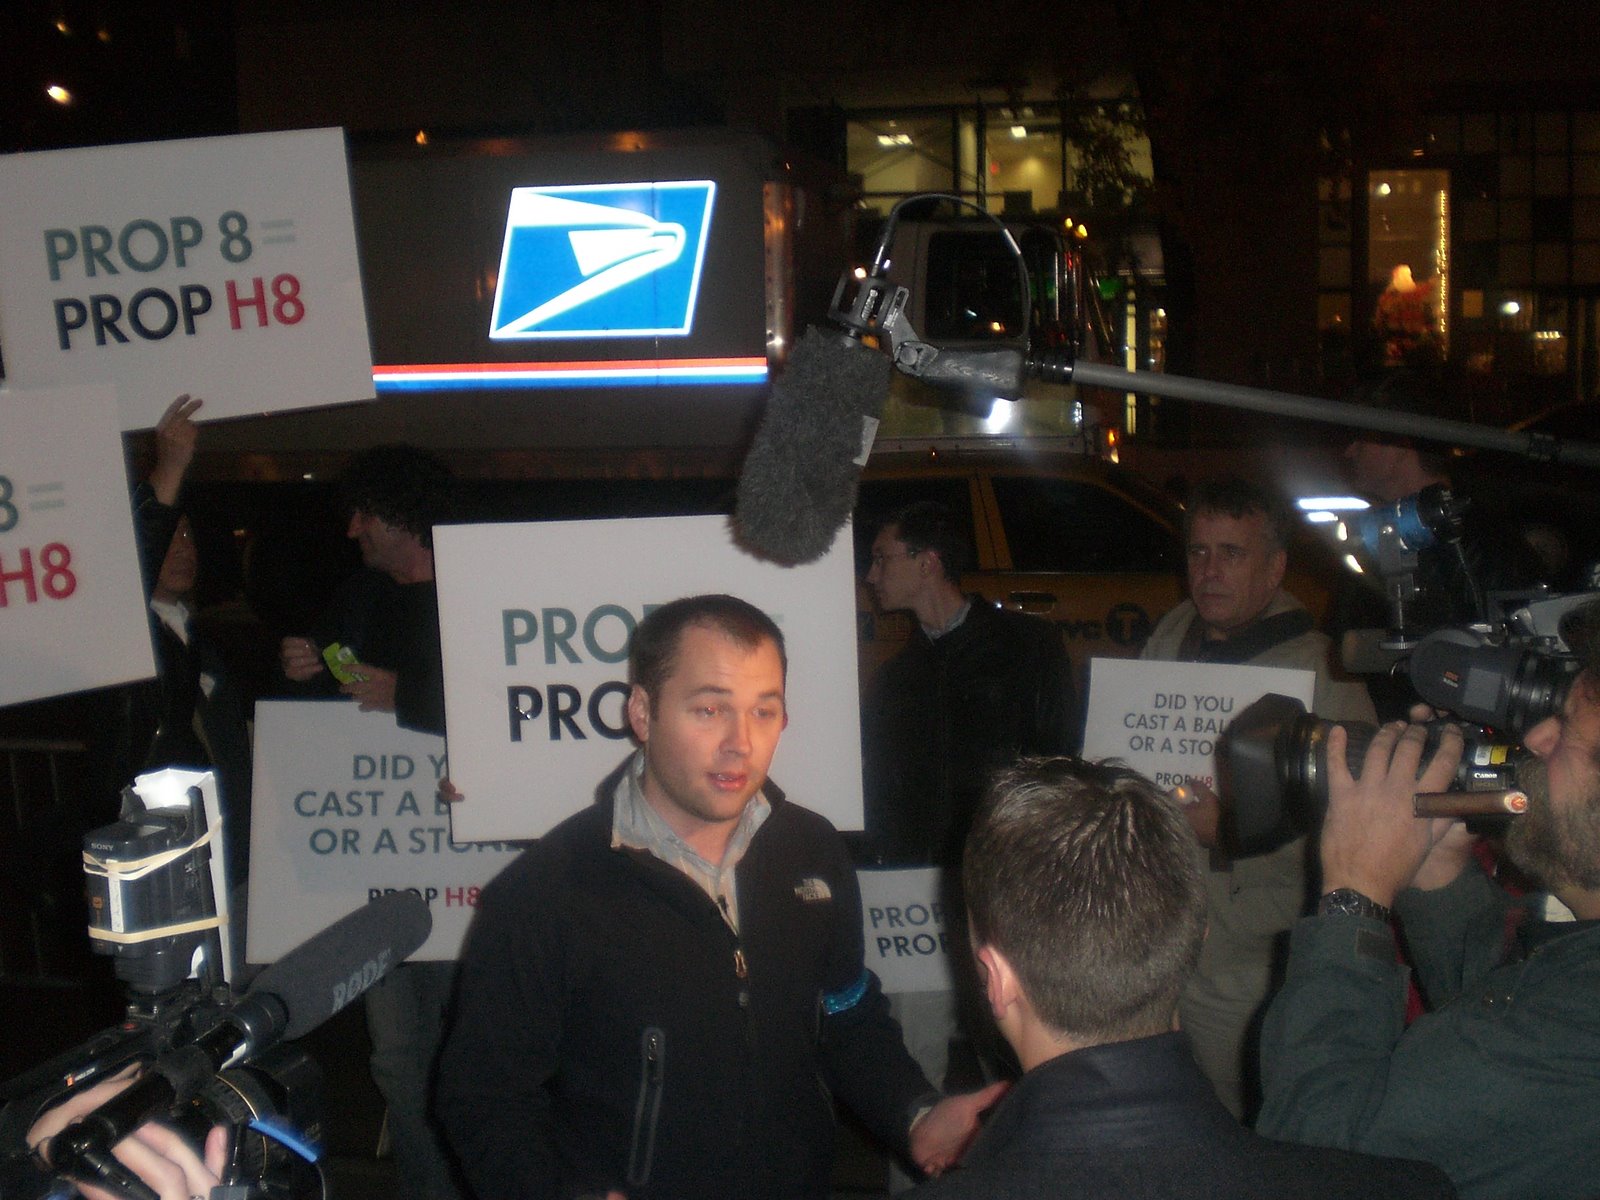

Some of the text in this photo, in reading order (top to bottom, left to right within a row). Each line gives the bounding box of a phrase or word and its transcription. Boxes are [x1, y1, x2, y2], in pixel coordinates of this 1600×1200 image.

[44, 216, 203, 281] PROP
[218, 210, 253, 263] 8
[53, 273, 305, 350] PROP H8
[0, 542, 77, 608] H8
[502, 603, 665, 666] PRO
[507, 680, 632, 742] PRO
[1154, 692, 1234, 713] DID YOU
[1123, 712, 1168, 731] CAST
[1173, 716, 1186, 732] A
[1129, 735, 1154, 752] OR
[1160, 737, 1173, 754] A
[352, 754, 415, 781] DID
[1155, 772, 1191, 786] PROP
[293, 790, 384, 817] CAST
[395, 791, 420, 817] A
[90, 842, 114, 851] SONY
[309, 828, 360, 855] OR
[372, 828, 398, 854] A
[445, 886, 483, 908] H8
